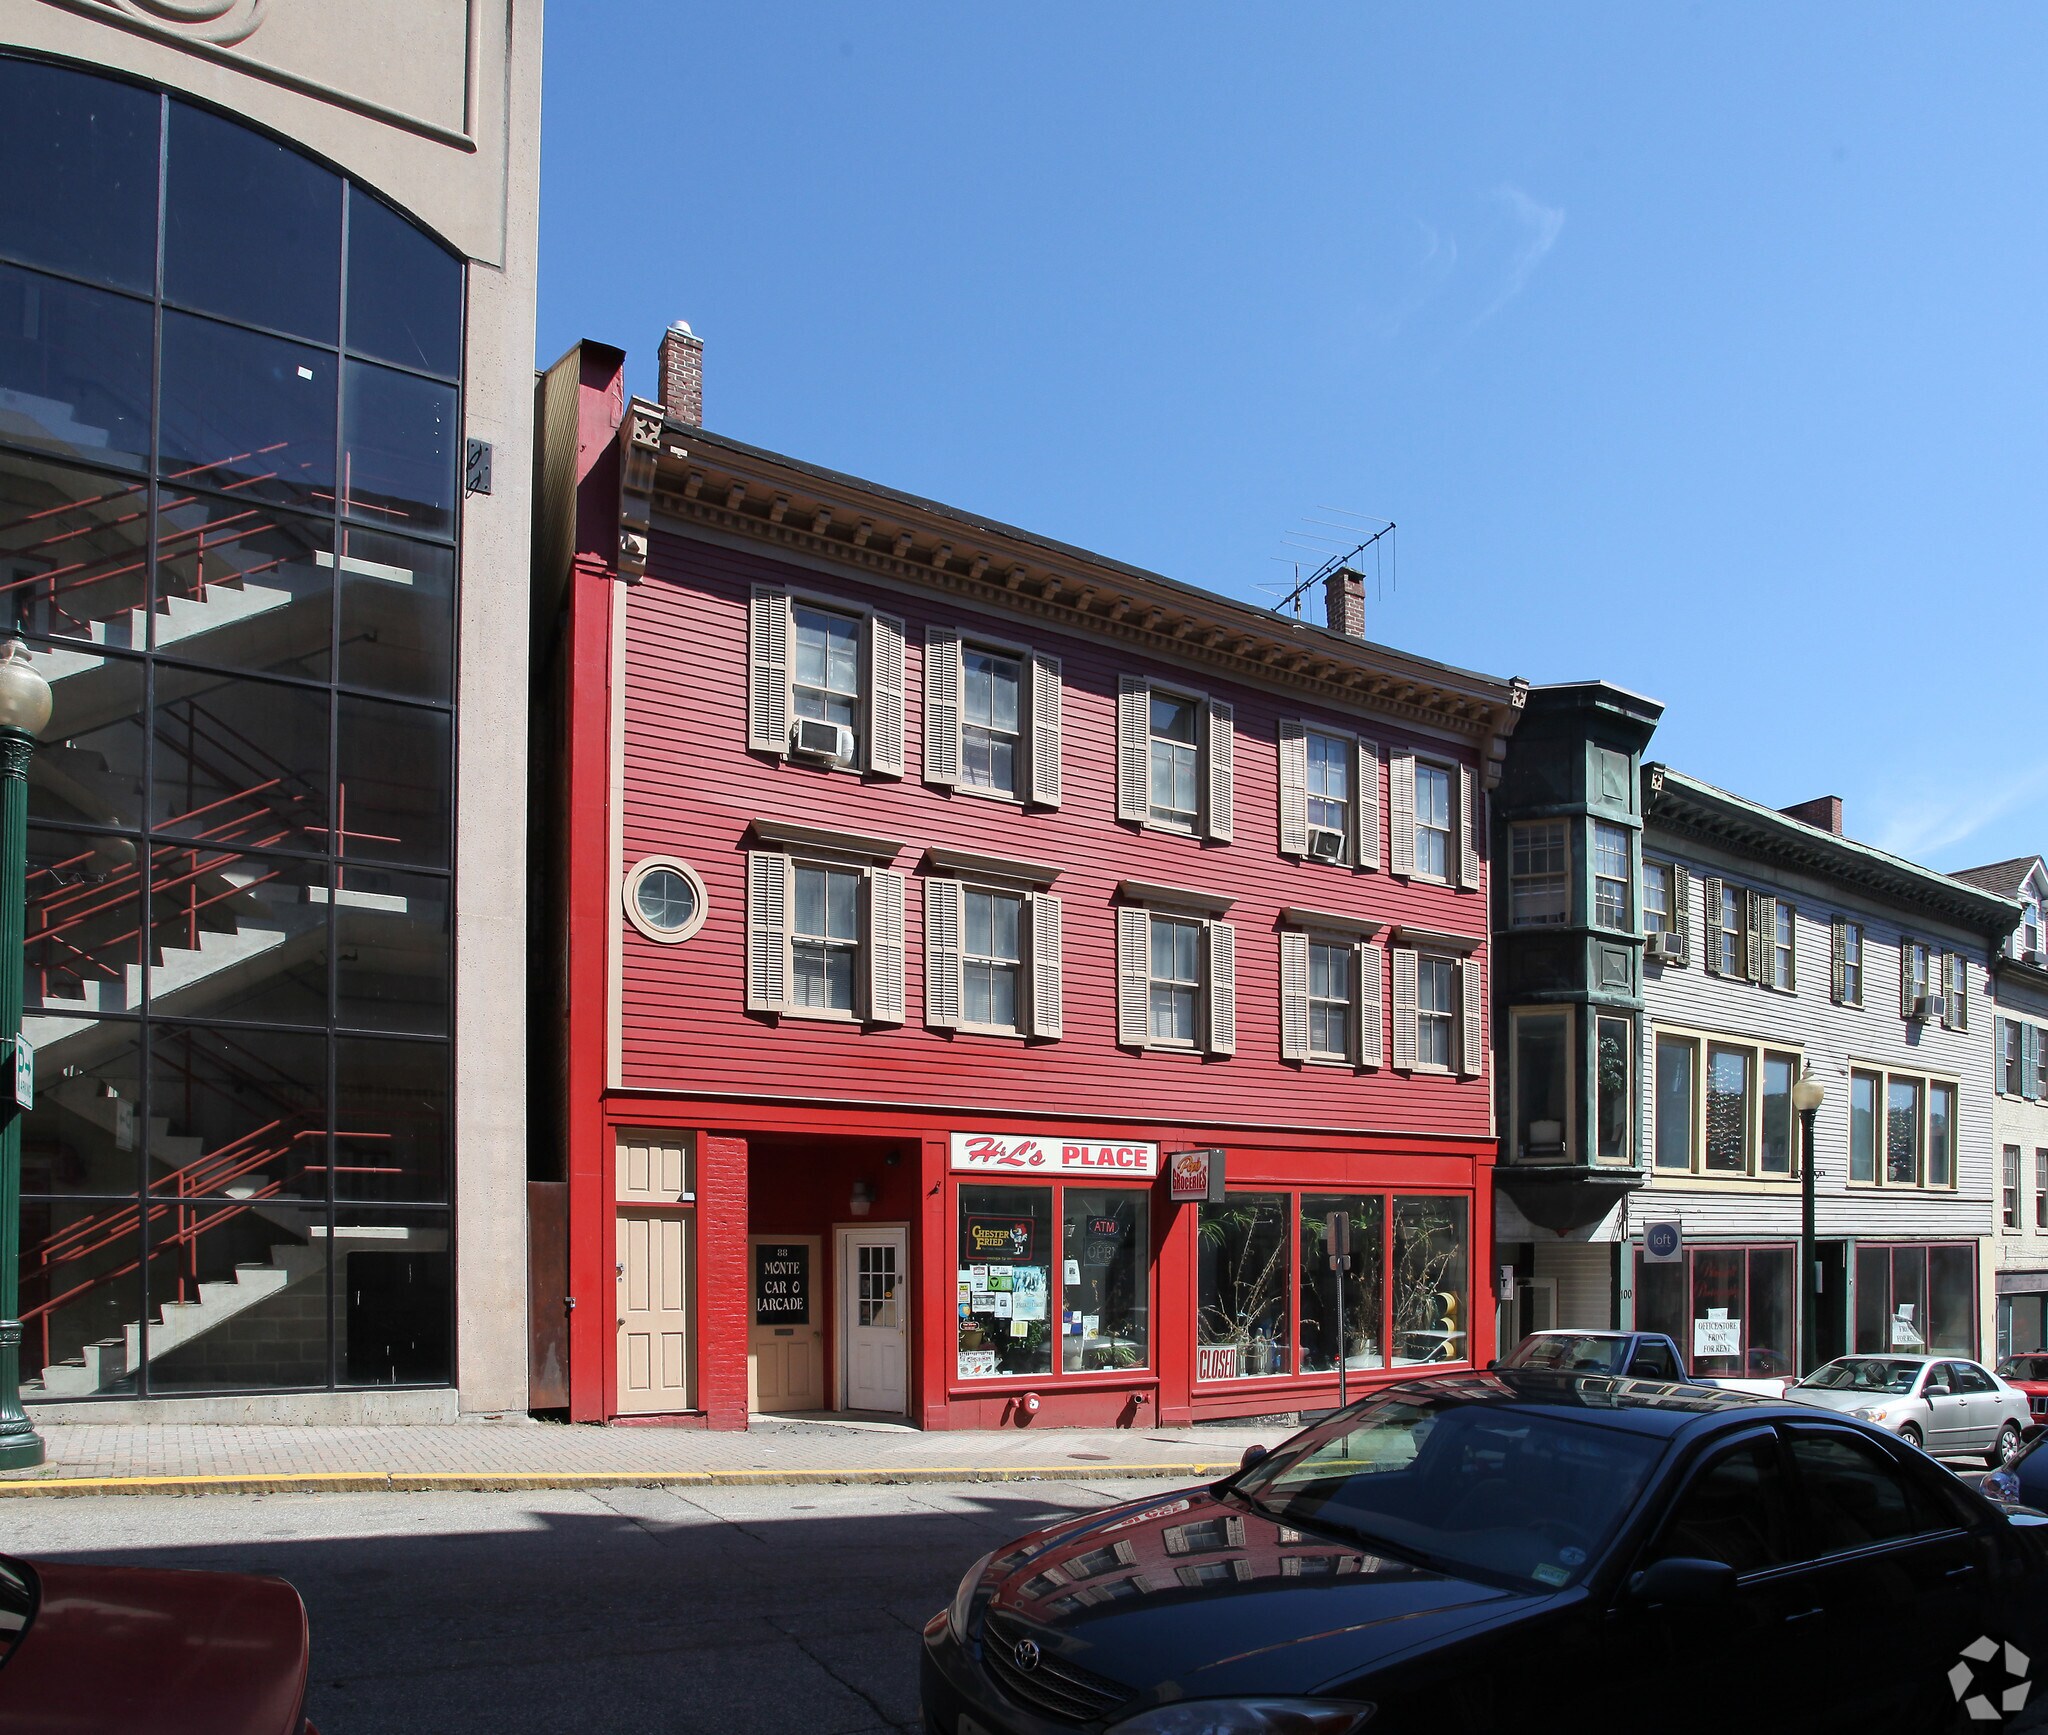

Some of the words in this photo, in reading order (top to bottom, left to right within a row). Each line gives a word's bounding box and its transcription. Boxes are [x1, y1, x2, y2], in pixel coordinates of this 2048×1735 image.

[1061, 1146, 1148, 1167] PLACE
[1172, 1166, 1207, 1189] GROCERIES
[1094, 1221, 1115, 1233] ATM
[1653, 1234, 1671, 1245] loft
[777, 1248, 788, 1257] 88
[764, 1261, 800, 1275] MONTE
[1620, 1289, 1632, 1300] 100
[1698, 1321, 1738, 1330] OFFICE/STORE
[1708, 1333, 1727, 1342] FRONT
[1703, 1344, 1715, 1353] FOR
[1716, 1344, 1731, 1353] RENT
[1200, 1349, 1236, 1379] CLOSED
